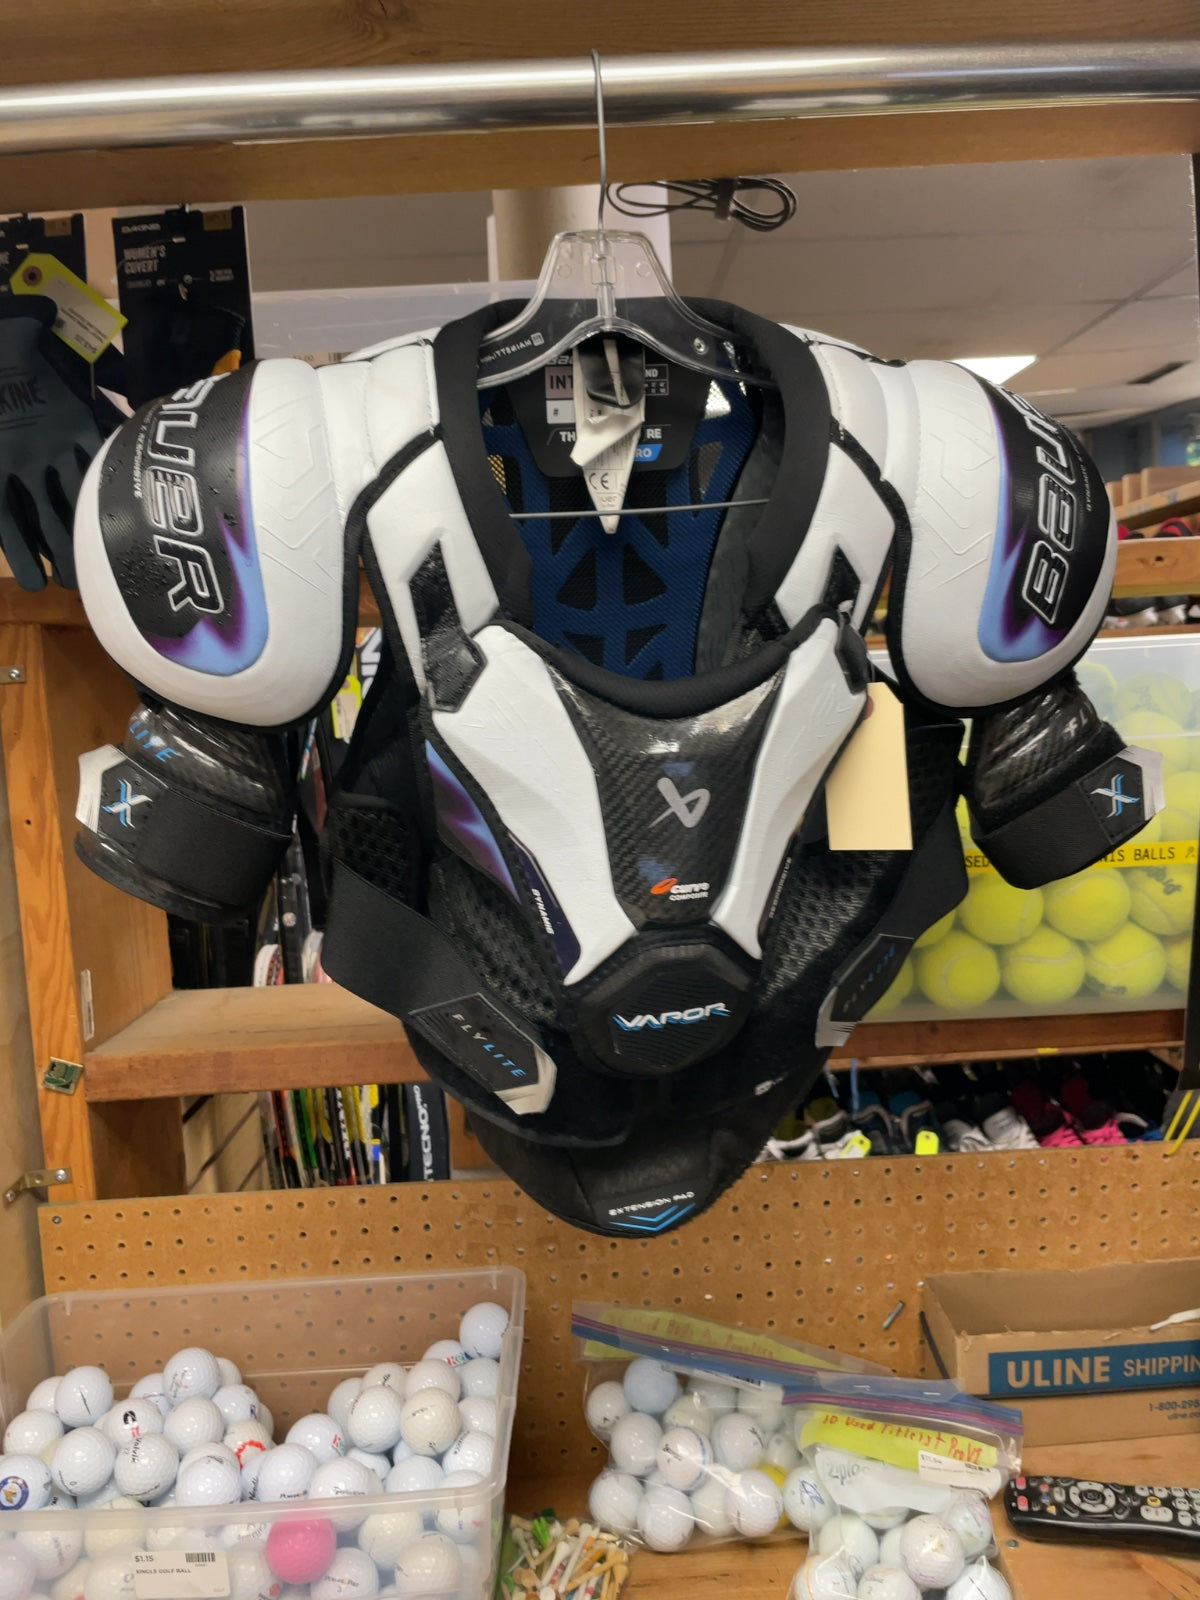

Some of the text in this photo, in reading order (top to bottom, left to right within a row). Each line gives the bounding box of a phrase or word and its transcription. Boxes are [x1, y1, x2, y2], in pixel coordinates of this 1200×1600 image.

[1133, 846, 1176, 862] BALLS
[531, 888, 555, 935] DYNAMIC
[613, 1002, 732, 1031] VAPOR
[608, 1197, 672, 1216] EXTENSION
[1007, 1355, 1111, 1389] ULINE
[845, 1416, 874, 1430] Used
[134, 1554, 154, 1563] $1.15
